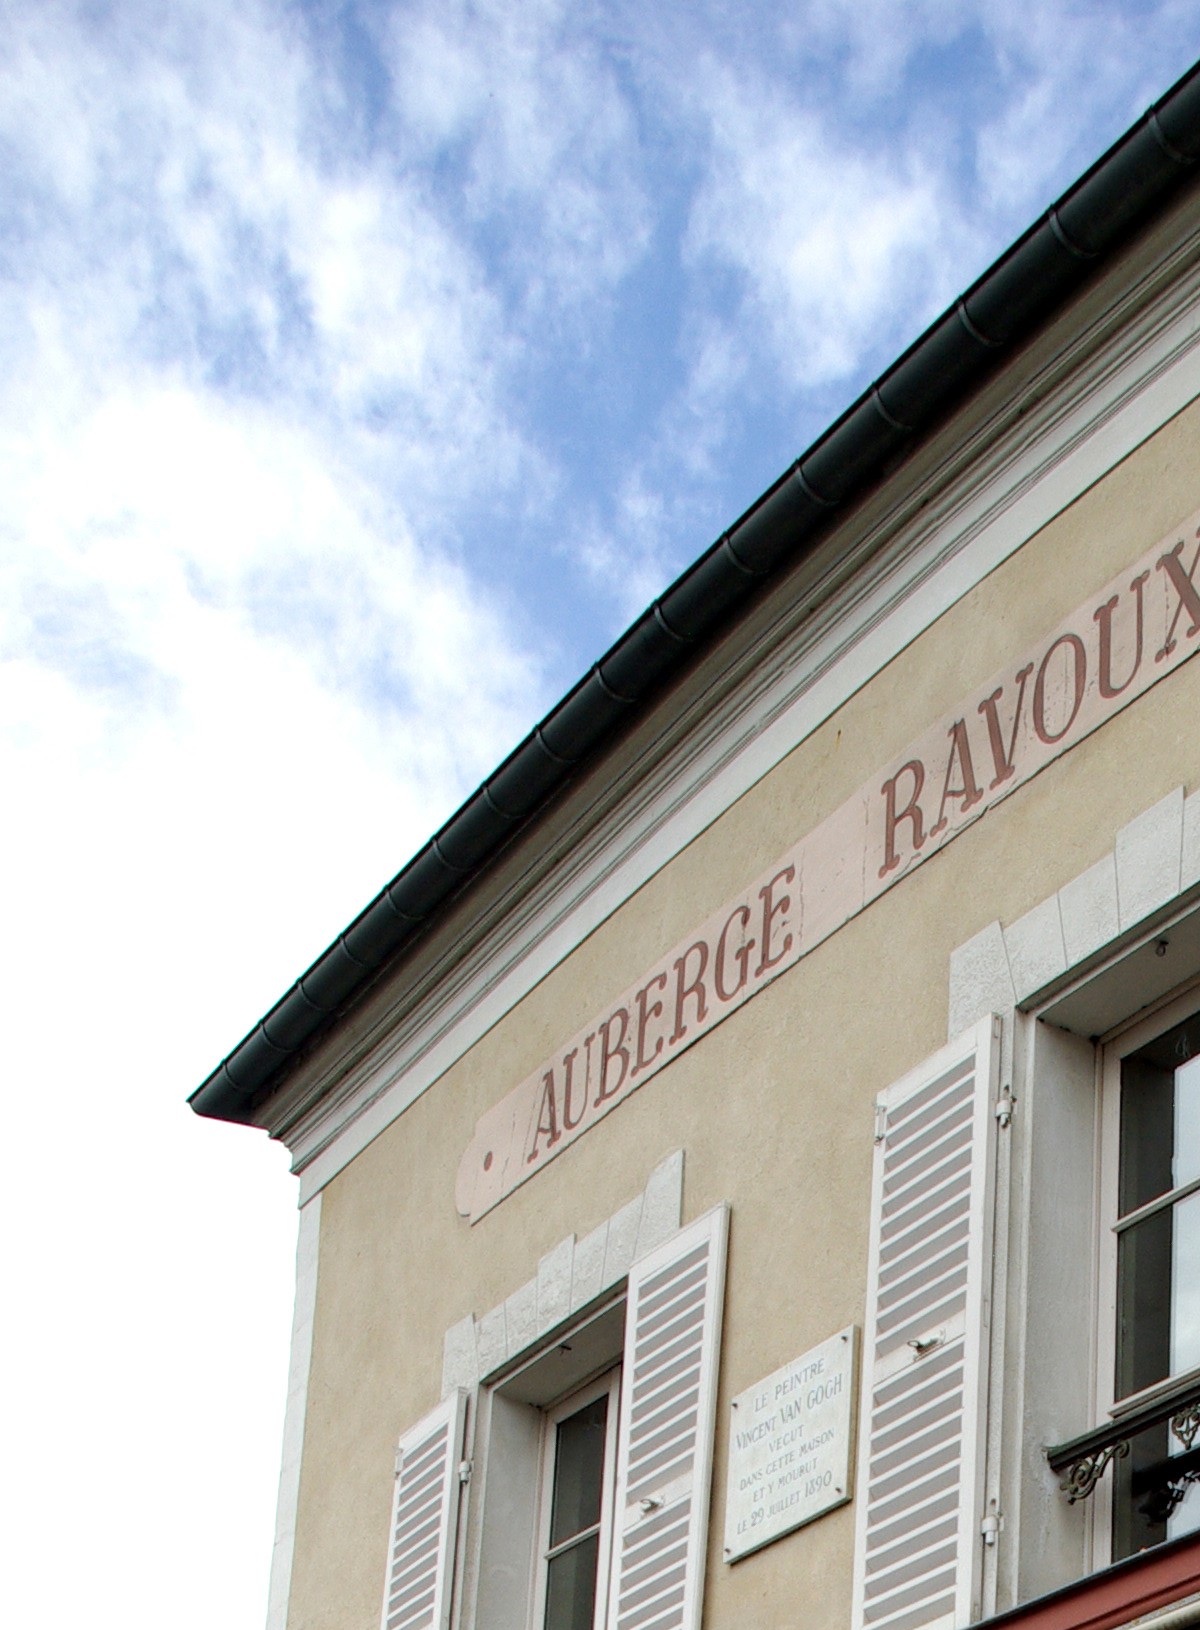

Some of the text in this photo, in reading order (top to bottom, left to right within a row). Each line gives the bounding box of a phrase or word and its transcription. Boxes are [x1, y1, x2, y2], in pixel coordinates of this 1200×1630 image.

[526, 862, 798, 1162] AUBERGE
[736, 1372, 842, 1449] VINCENT VAN GOGH
[754, 1358, 825, 1412] LE PEINTRE
[740, 1428, 835, 1491] DANS CETTE MAISON
[753, 1457, 818, 1502] ET Y MOURUT
[737, 1470, 832, 1534] LE 29 JUILLET 1890
